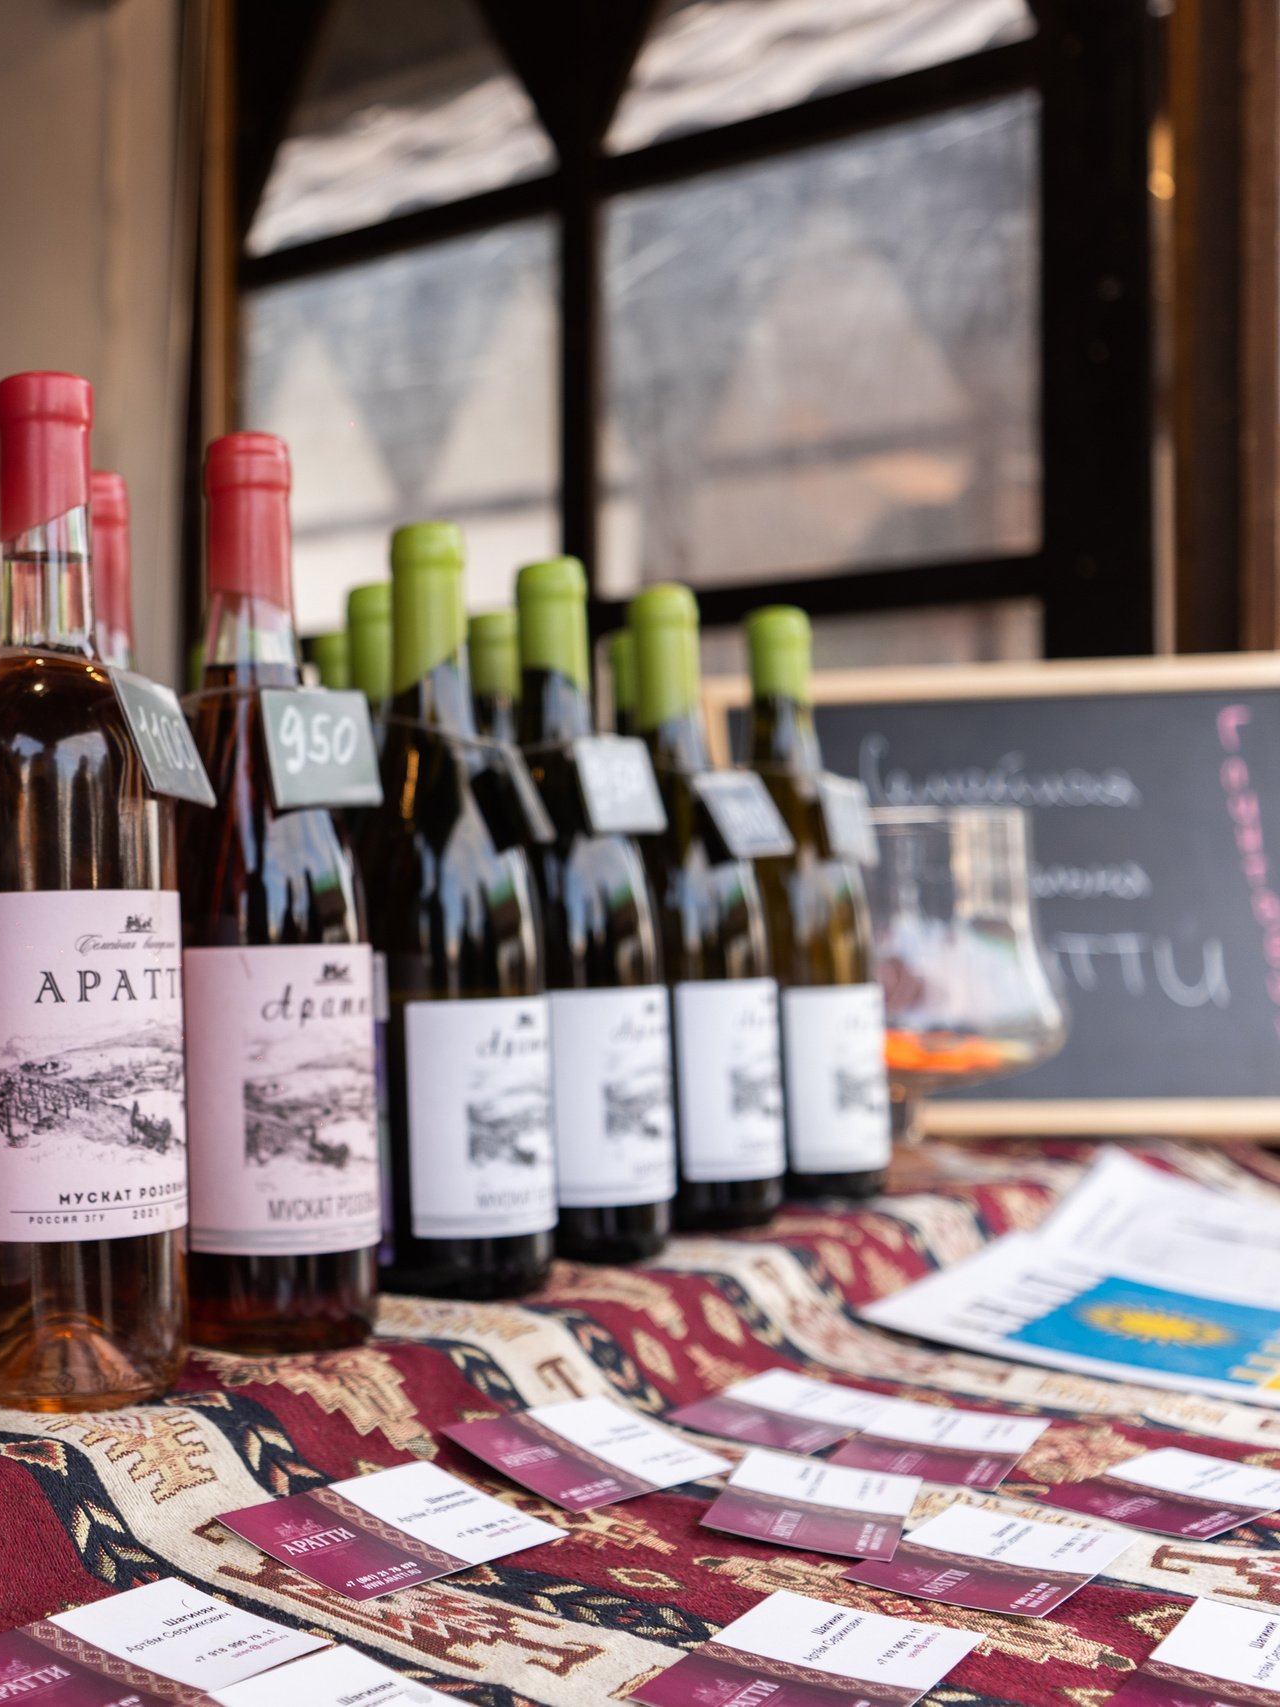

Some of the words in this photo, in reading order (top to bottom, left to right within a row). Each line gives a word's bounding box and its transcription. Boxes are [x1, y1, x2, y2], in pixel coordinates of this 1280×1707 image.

[277, 703, 358, 775] 950
[58, 1189, 132, 1206] МУСКАТ
[28, 1216, 78, 1225] РОССИЯ
[280, 1526, 357, 1557] АРАТТИ
[161, 1605, 218, 1627] Шагинян
[810, 1611, 848, 1636] Шагинян
[125, 1636, 165, 1654] Артём
[162, 1611, 232, 1639] Сержикович
[262, 1628, 276, 1636] 11
